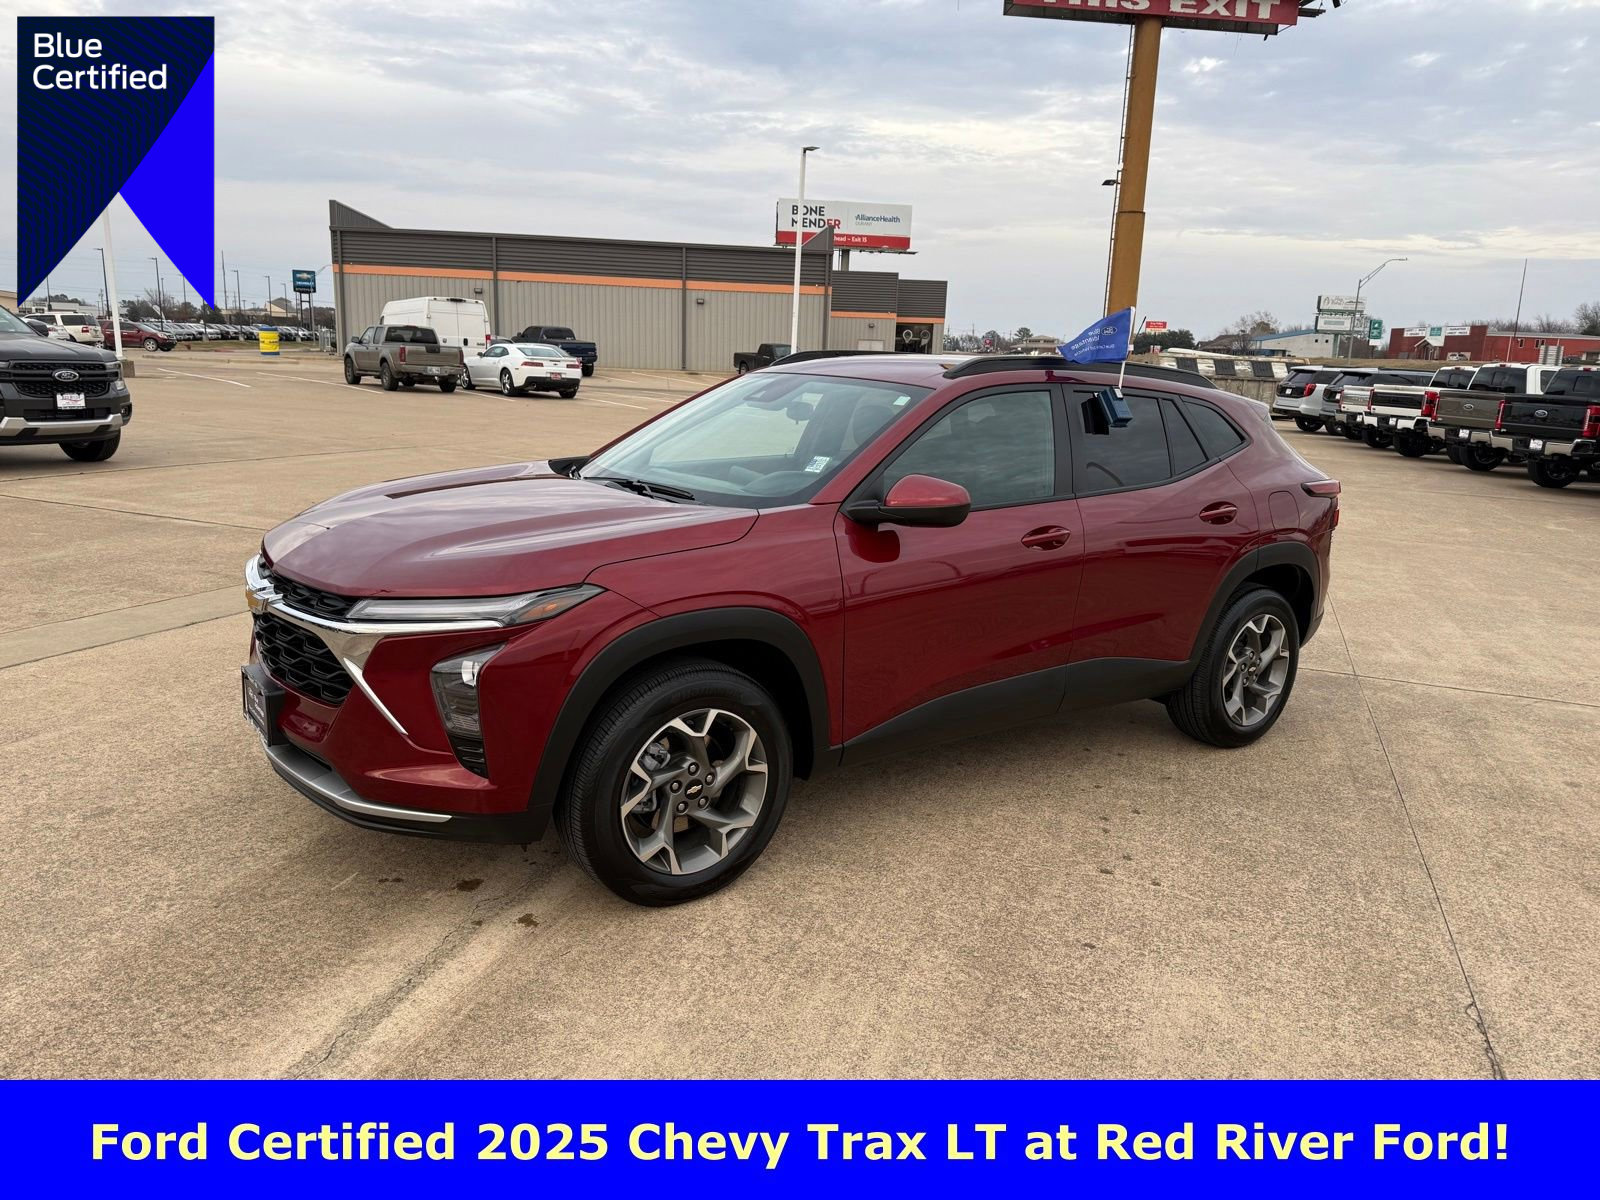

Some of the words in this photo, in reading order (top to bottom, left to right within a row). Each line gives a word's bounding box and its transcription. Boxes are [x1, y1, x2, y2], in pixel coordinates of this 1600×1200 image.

[1169, 0, 1281, 19] EXIT
[791, 204, 826, 217] BONE
[855, 213, 901, 223] AllianceHealth
